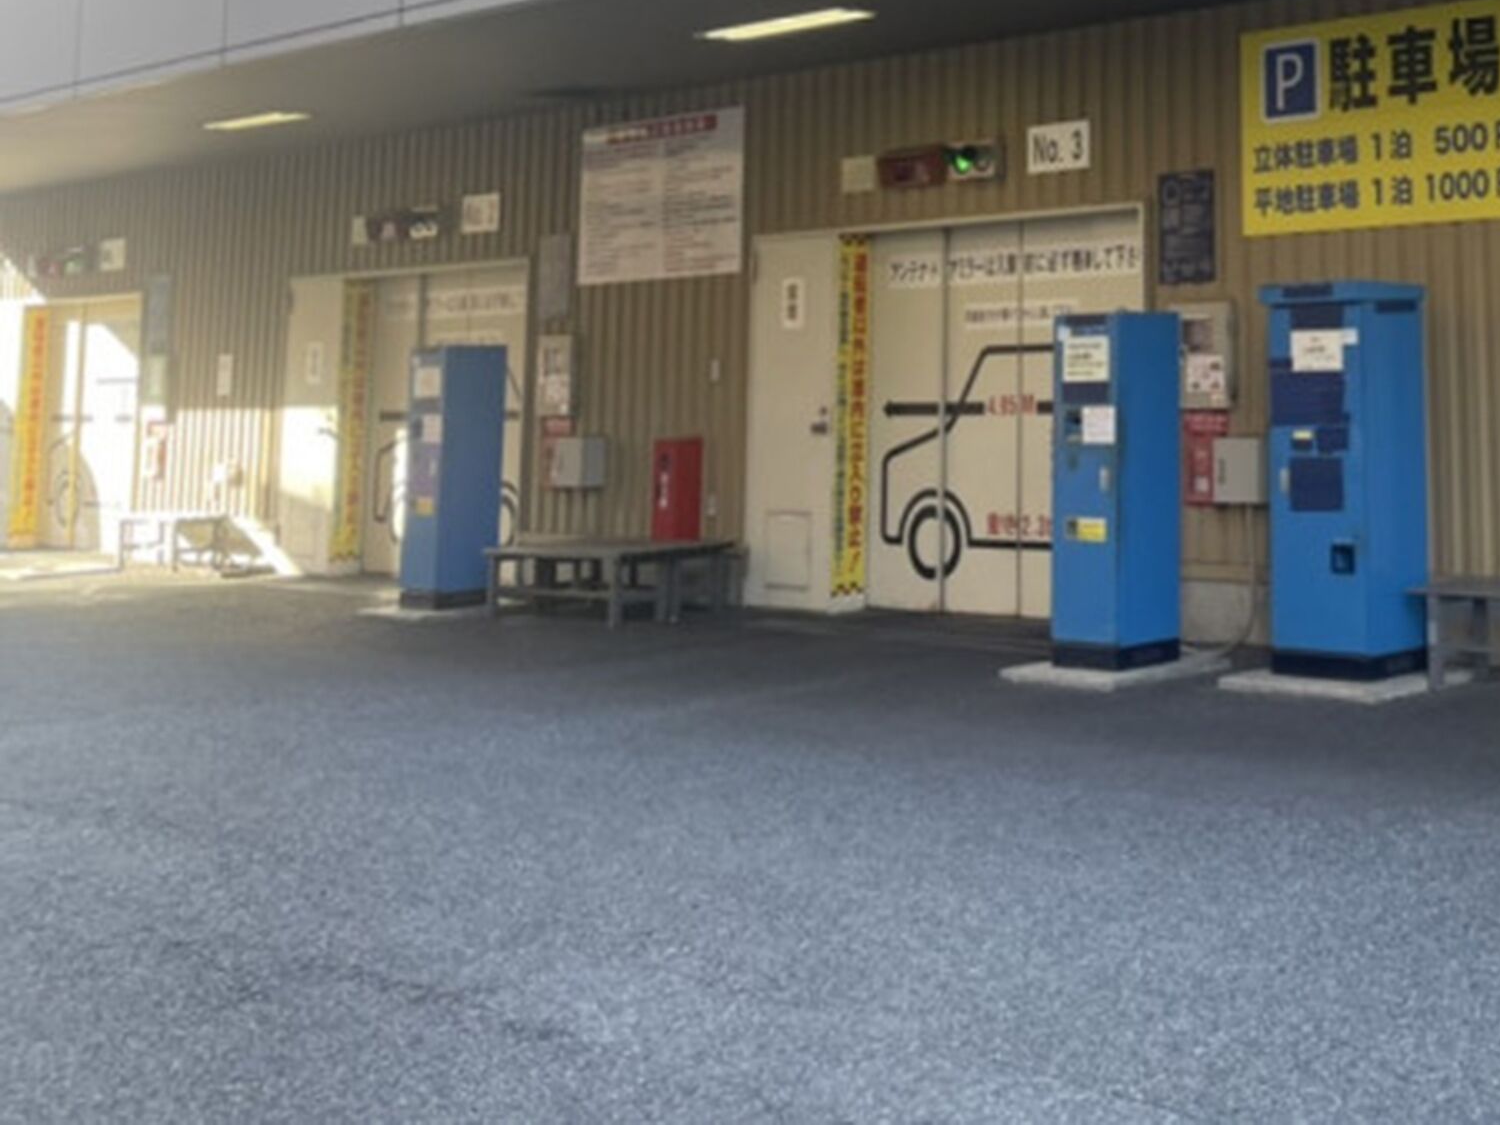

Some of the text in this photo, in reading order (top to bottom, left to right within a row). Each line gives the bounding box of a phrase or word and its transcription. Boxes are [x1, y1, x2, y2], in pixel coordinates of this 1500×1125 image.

[1328, 15, 1500, 112] 駐車場
[1071, 128, 1084, 162] 3
[1253, 134, 1359, 173] 立体駐車場
[1254, 179, 1360, 217] 平地駐車場
